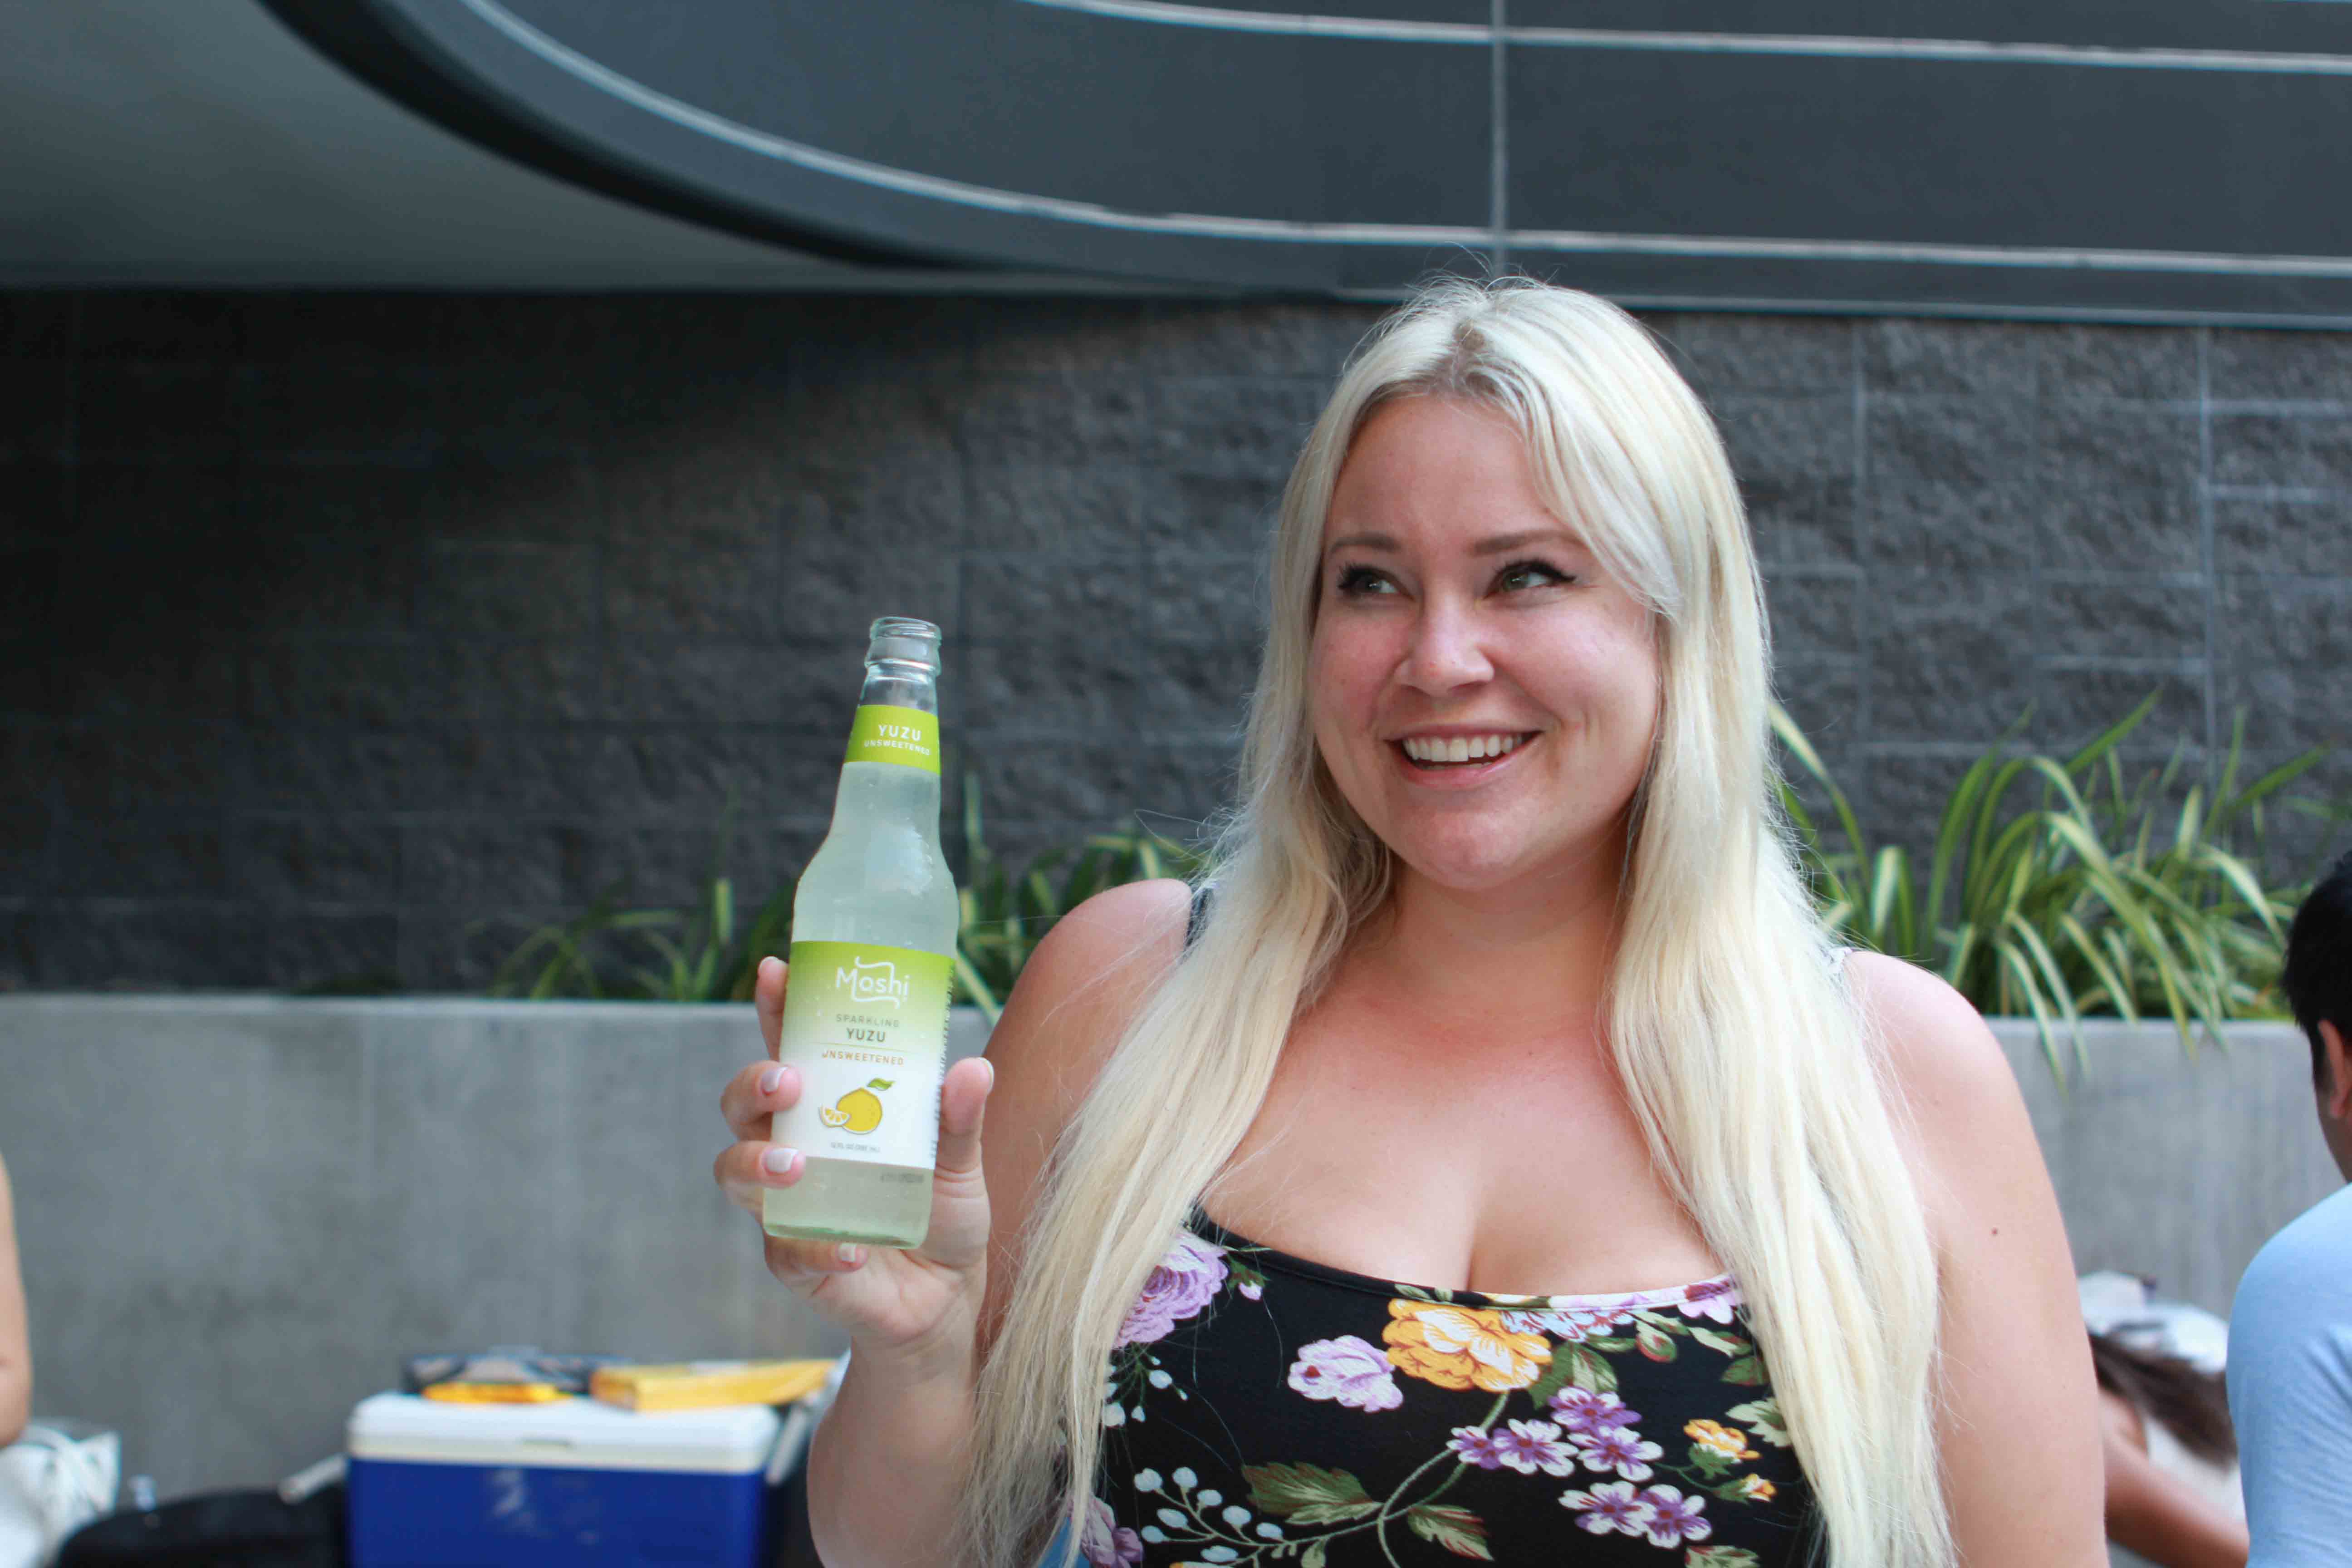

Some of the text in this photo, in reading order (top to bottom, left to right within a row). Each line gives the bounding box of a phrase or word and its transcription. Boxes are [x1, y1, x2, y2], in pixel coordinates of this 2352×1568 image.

[879, 725, 921, 741] YUZU
[864, 740, 931, 755] UNSWEETENED
[835, 956, 910, 1009] Moshi
[836, 1014, 900, 1028] SPARKLING
[847, 1028, 886, 1042] YUZU
[822, 1050, 904, 1065] UNSWEETENED
